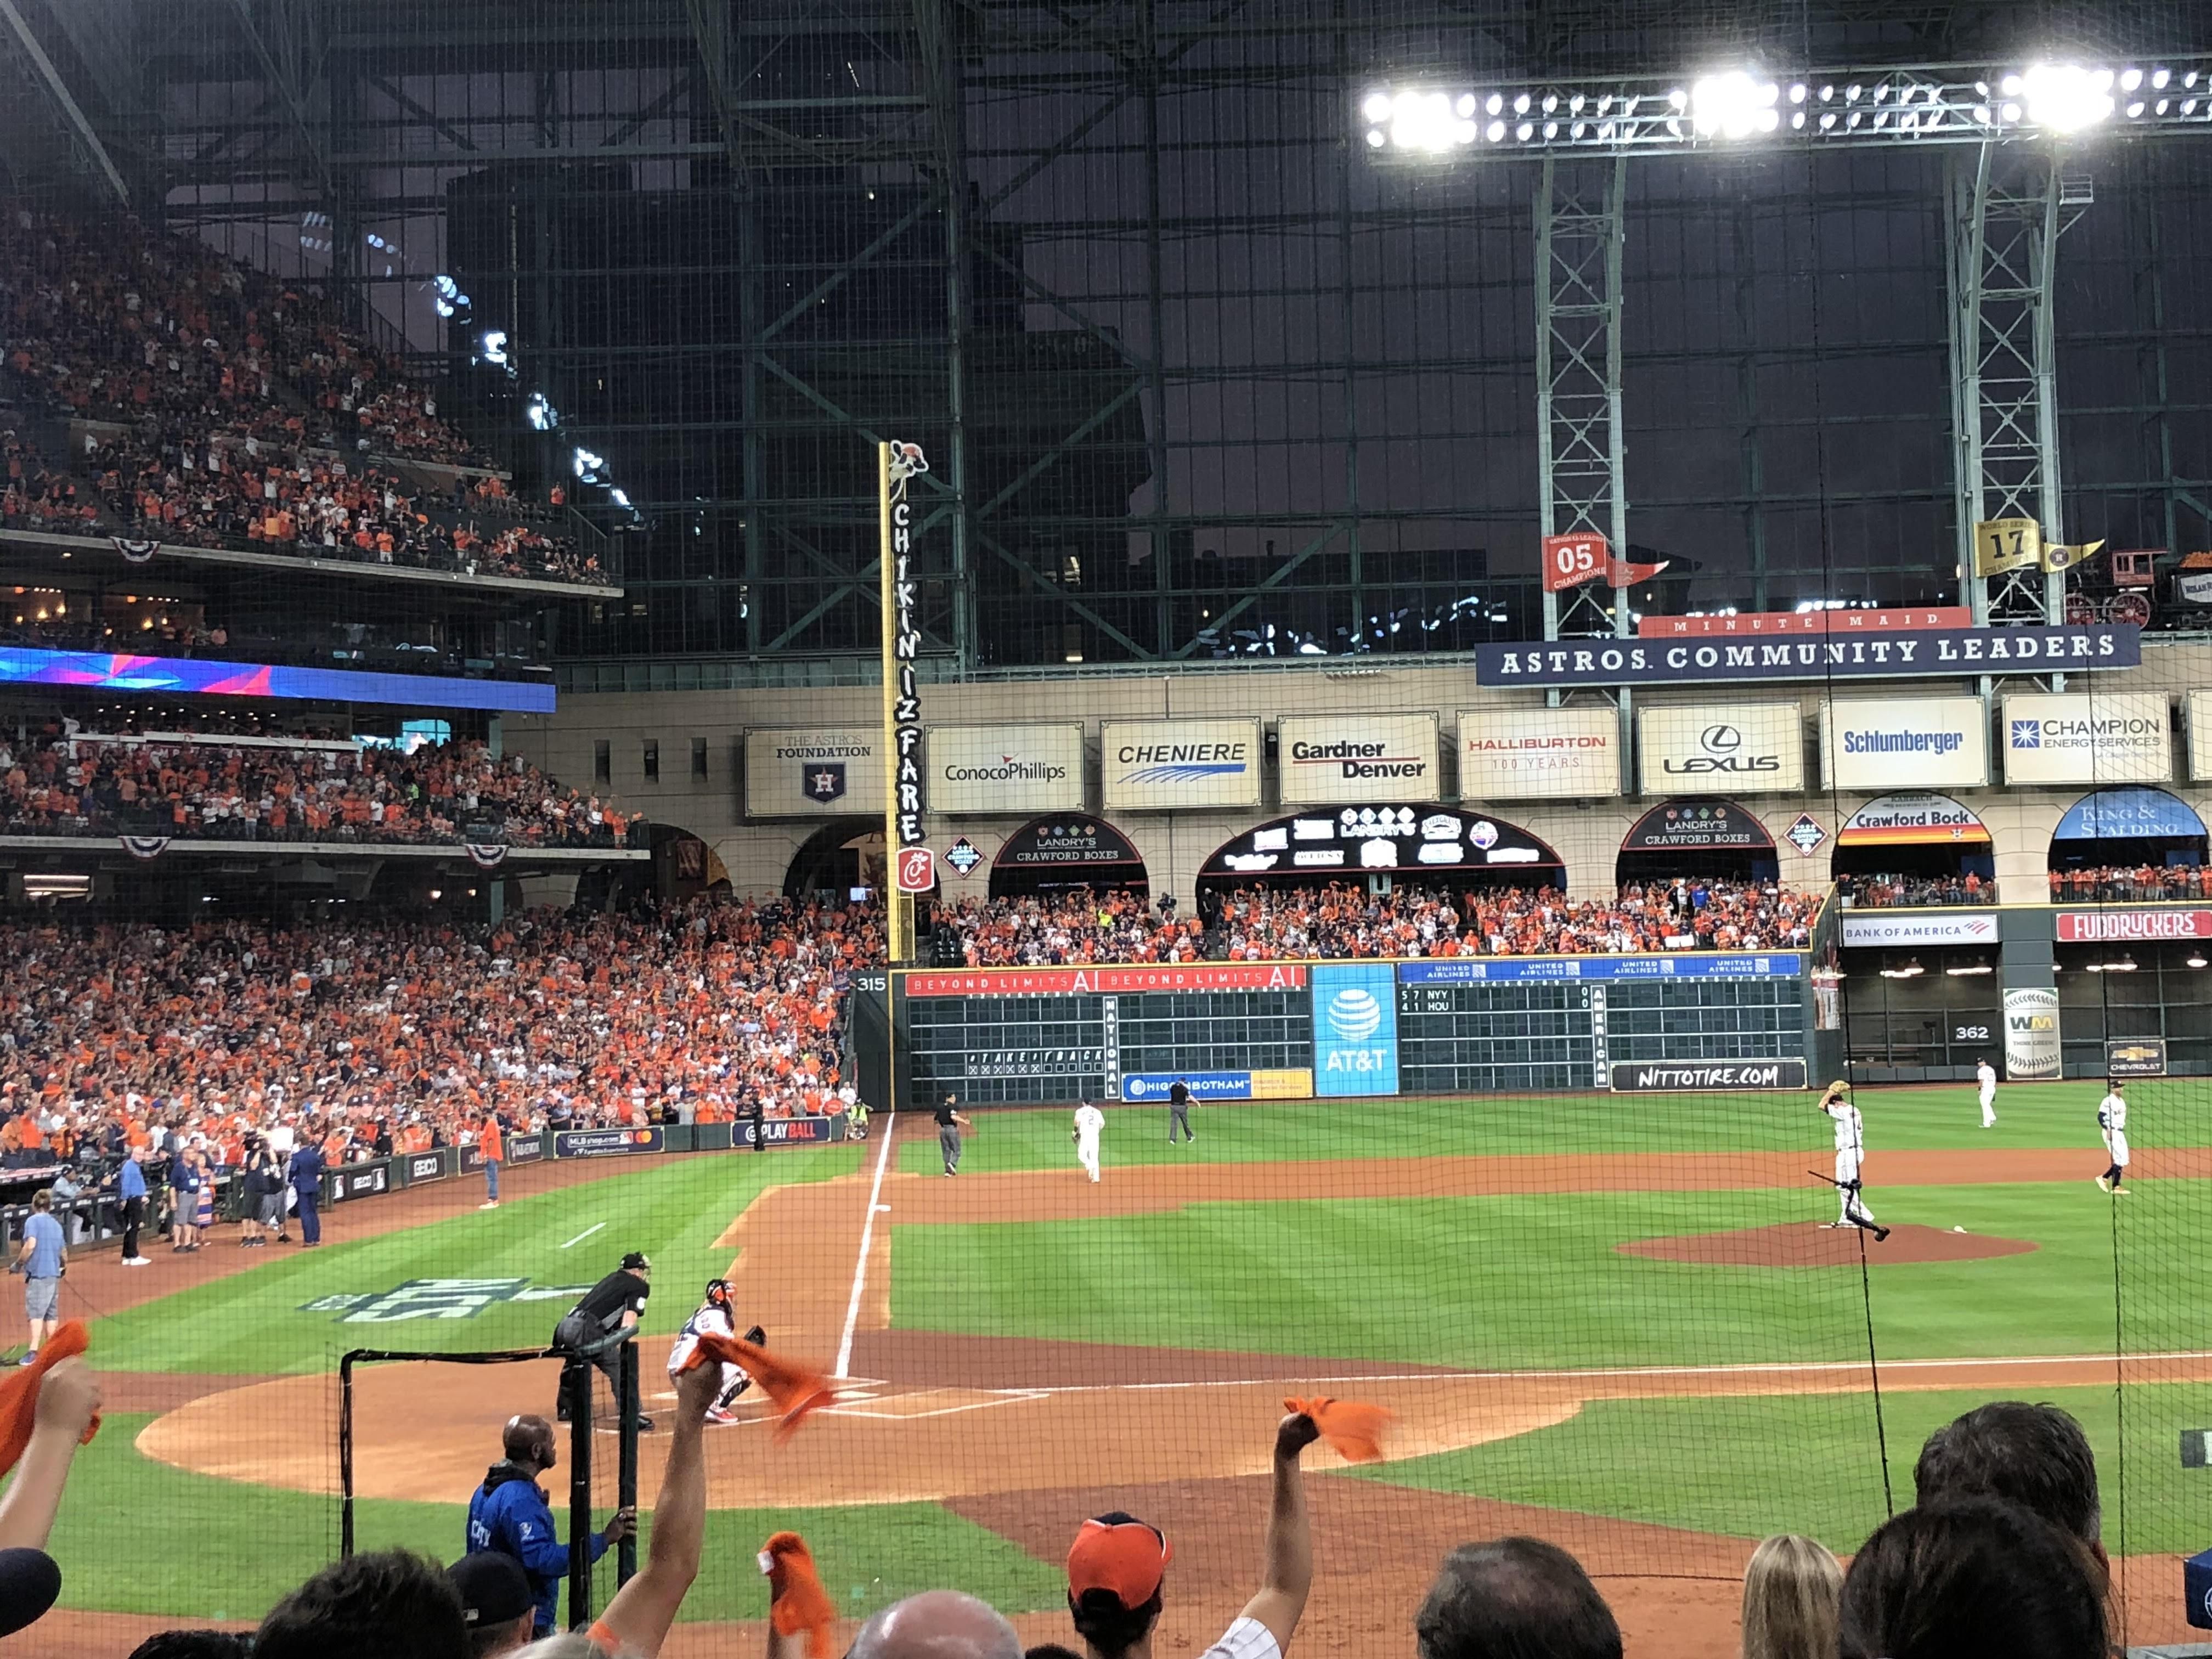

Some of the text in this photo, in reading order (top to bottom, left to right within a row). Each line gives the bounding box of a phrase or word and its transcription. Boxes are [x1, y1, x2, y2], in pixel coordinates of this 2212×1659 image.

[1990, 530, 2024, 558] 17
[1557, 543, 1593, 574] 05
[894, 503, 916, 658] CHIKIN
[1674, 613, 1938, 632] MINUTE MAID
[1500, 634, 2115, 674] ASTROS COMMUNITY LEADERS
[2043, 719, 2160, 736] CHAMPION
[785, 735, 862, 747] THE ASTROS
[1470, 736, 1606, 751] HALLIBURTON
[1844, 730, 1963, 755] Schlumberger
[2044, 737, 2161, 748] ENERGY SERVICES
[777, 747, 871, 758] FOUNDATION
[1118, 743, 1246, 763] CHENIERE
[1292, 740, 1386, 760] Gardner
[1342, 760, 1426, 779] Denver
[1493, 756, 1581, 769] 100 YEARS
[1664, 755, 1780, 774] LEXUS
[945, 761, 1066, 783] ConocoPhillips
[899, 730, 920, 842] FARE
[1856, 810, 1969, 828] Crawford Bock
[2138, 804, 2155, 820] &
[1666, 820, 1727, 830] LANDRY'S
[1036, 837, 1097, 847] LANDRY'S
[1645, 833, 1751, 845] CRAWFORD BOXES
[1017, 850, 1119, 861] CRAWFORD BOXES
[1846, 925, 1962, 938] BANK OF AMERICA
[2074, 912, 2196, 939] FUDDRUCKERS
[857, 977, 886, 991] 315
[914, 979, 989, 991] BEYOND
[1000, 977, 1068, 988] LIMITS
[1111, 973, 1184, 985] BEYOND
[1197, 972, 1262, 984] LIMITS
[1427, 990, 1448, 1000] NYY
[1582, 987, 1588, 996] 0
[1427, 1001, 1449, 1011] HOU
[1582, 1000, 1588, 1008] 0
[2010, 1015, 2054, 1030] WM
[1594, 990, 1606, 1082] AMERICAN
[1955, 1026, 1989, 1039] 362
[1105, 1000, 1116, 1095] NATIONAL
[1326, 1048, 1387, 1072] AT&T
[2111, 1063, 2162, 1071] CHEVROLET
[1639, 1065, 1779, 1087] NITTOTIRE.COM
[1147, 1079, 1244, 1092] HIGNBOTHAM
[414, 1157, 438, 1177] GEICO
